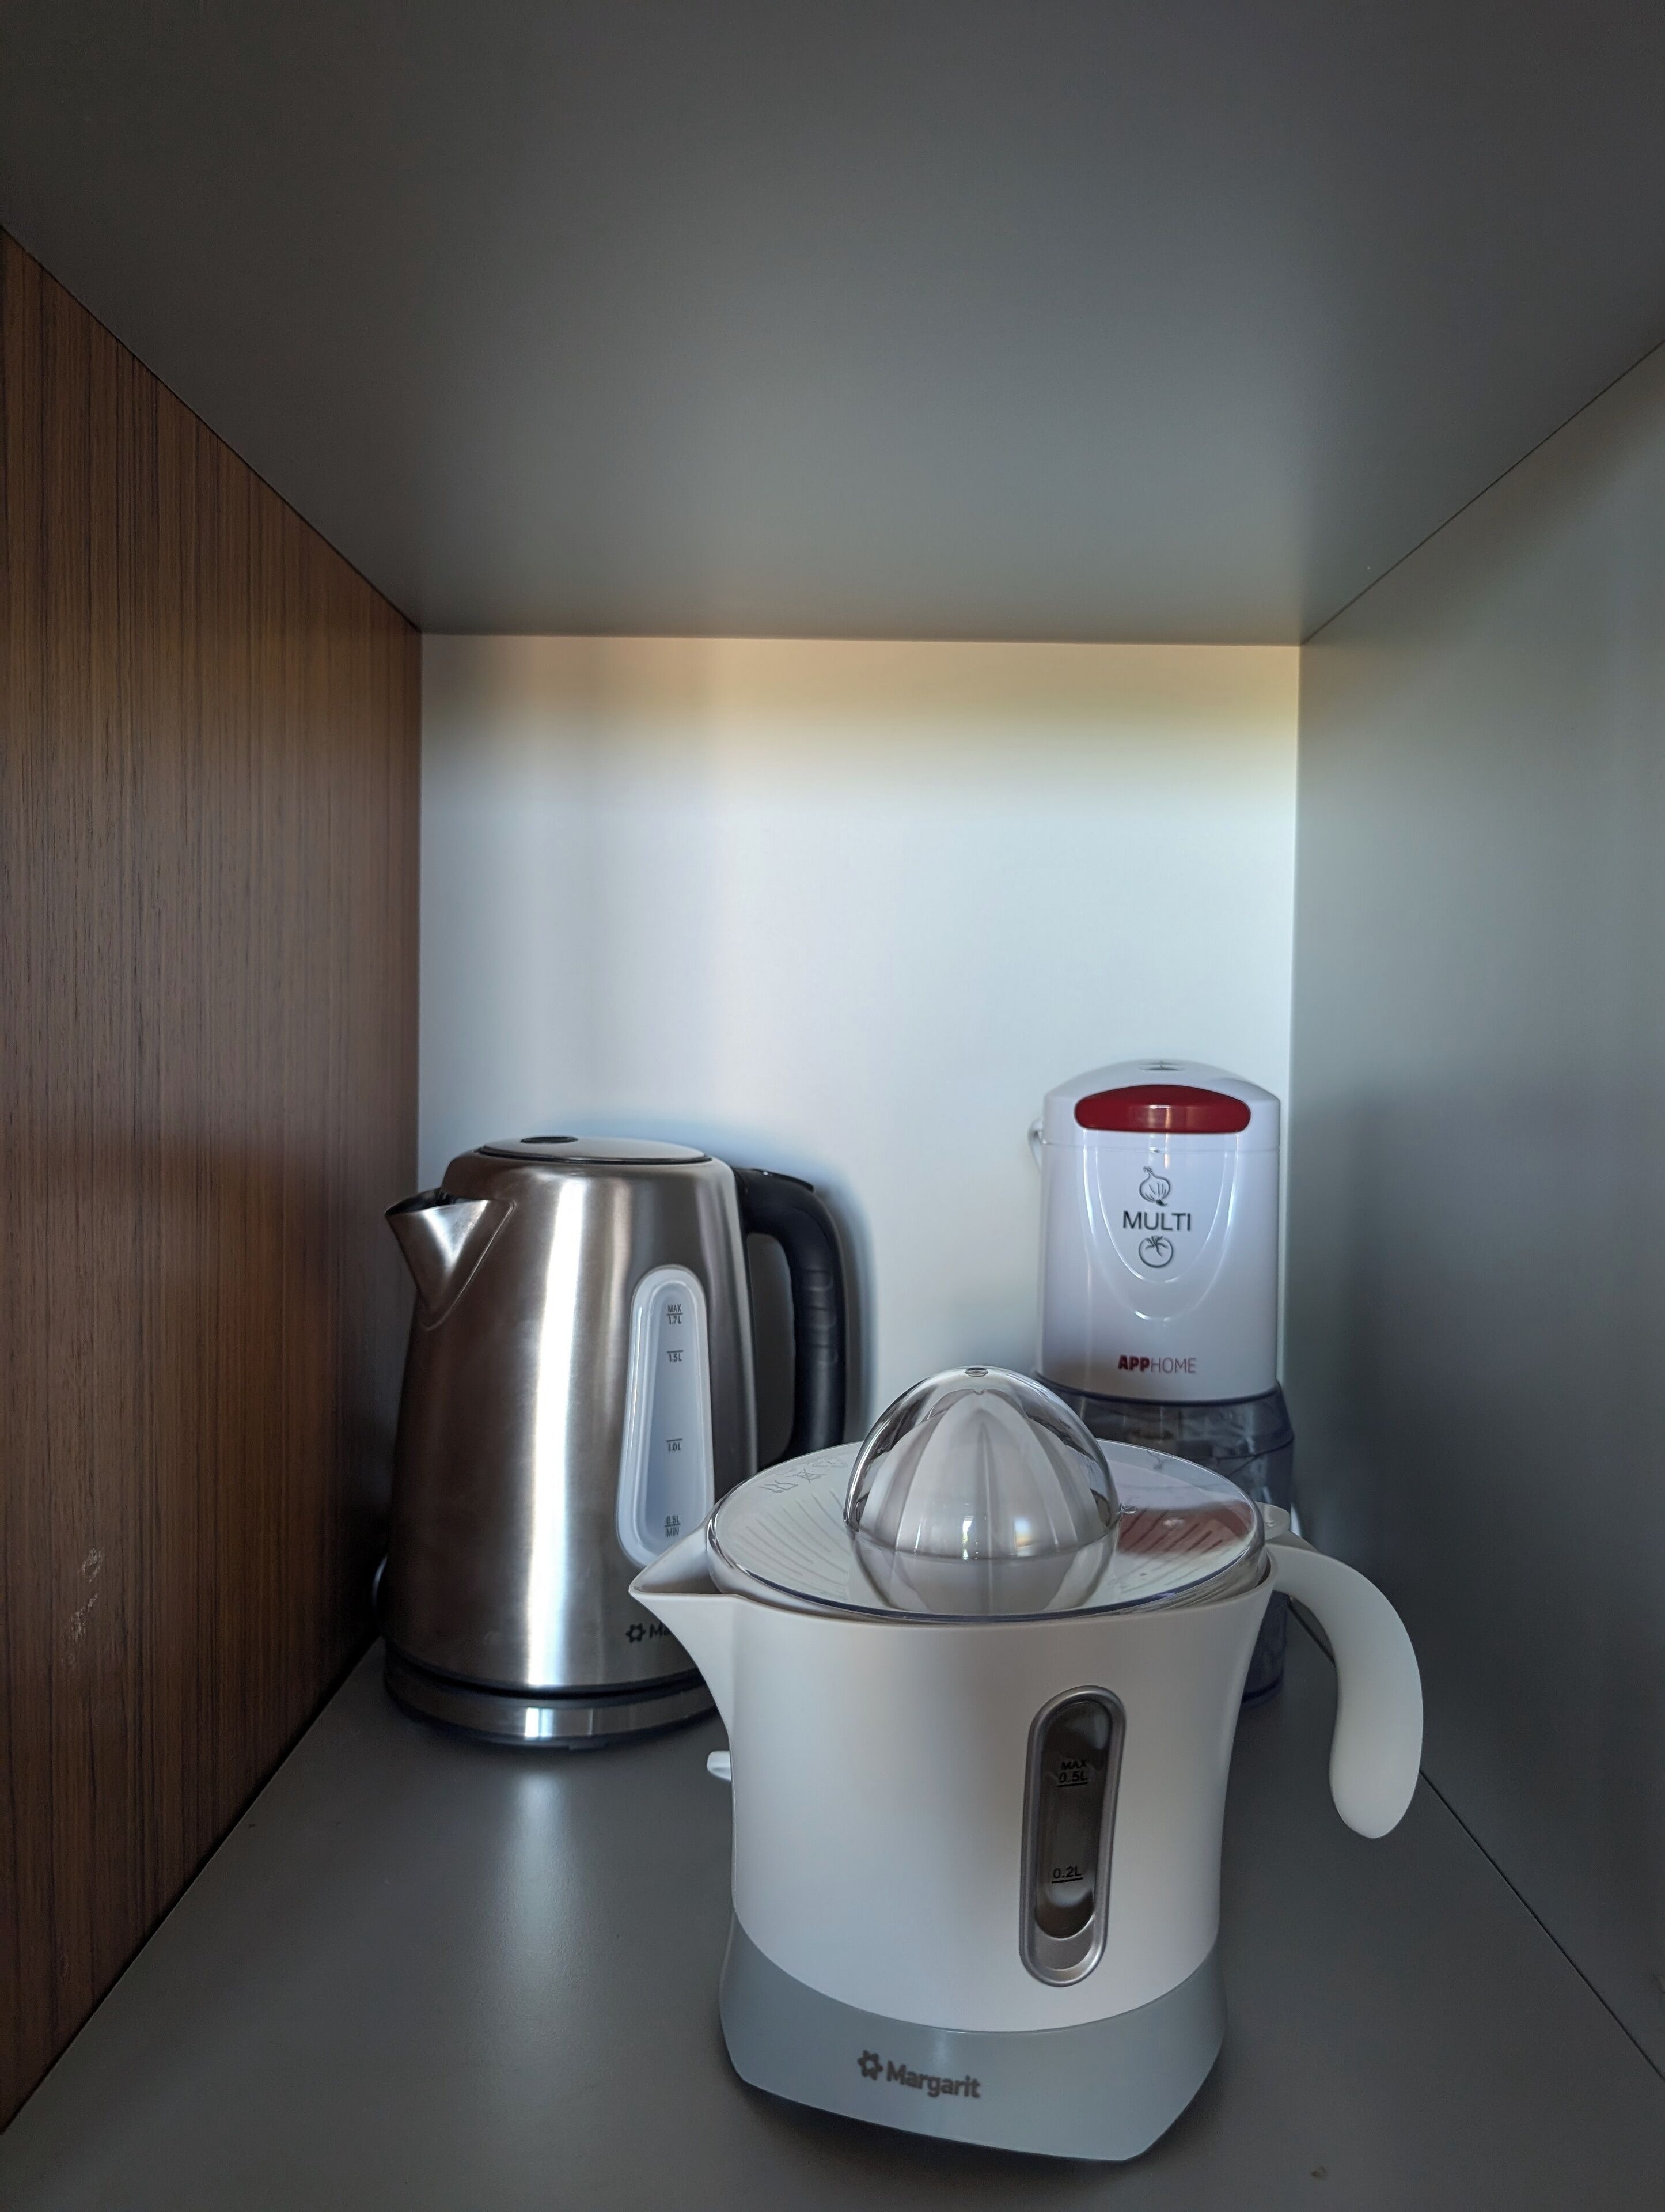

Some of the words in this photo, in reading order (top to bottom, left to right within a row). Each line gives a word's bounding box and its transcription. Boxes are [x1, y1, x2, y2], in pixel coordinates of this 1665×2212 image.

[1123, 1211, 1191, 1231] MULTI
[668, 1304, 682, 1313] MAX
[669, 1354, 682, 1362] 1.5L
[1118, 1355, 1196, 1373] APPHOME
[668, 1442, 681, 1452] 1.0L
[666, 1515, 679, 1525] 0.5L
[666, 1528, 680, 1537] MIN
[1061, 1759, 1088, 1770] MAX
[1059, 1770, 1088, 1783] 0.5L
[1053, 1866, 1082, 1880] 0.2L
[886, 2060, 981, 2097] Margarit
